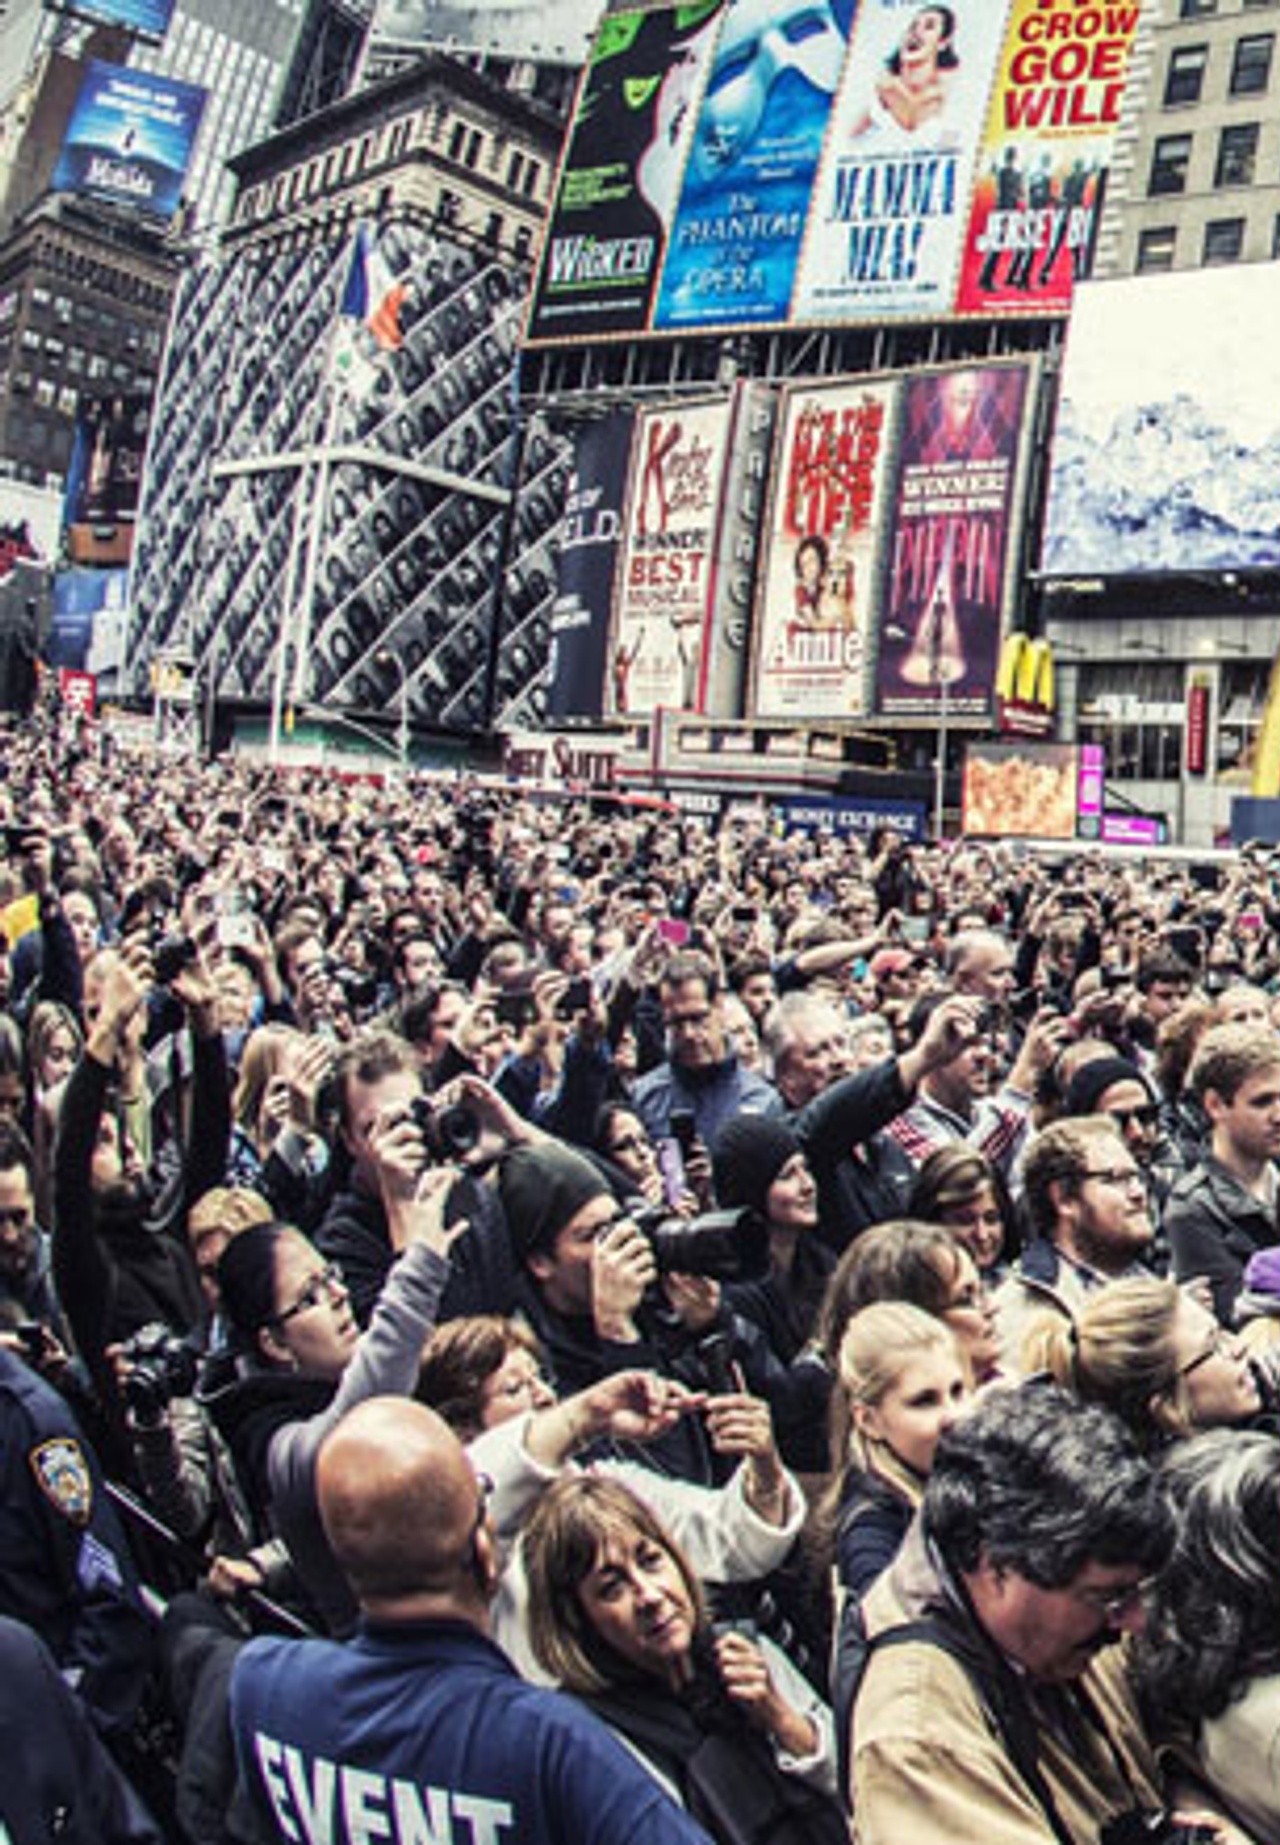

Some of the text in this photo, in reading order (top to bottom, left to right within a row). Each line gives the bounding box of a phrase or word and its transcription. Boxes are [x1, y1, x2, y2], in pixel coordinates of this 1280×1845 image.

[1019, 8, 1139, 42] CROW
[1010, 40, 1134, 85] GOE
[976, 207, 1064, 252] JERSEY
[629, 552, 705, 586] BEST
[255, 1731, 514, 1845] EVENT
